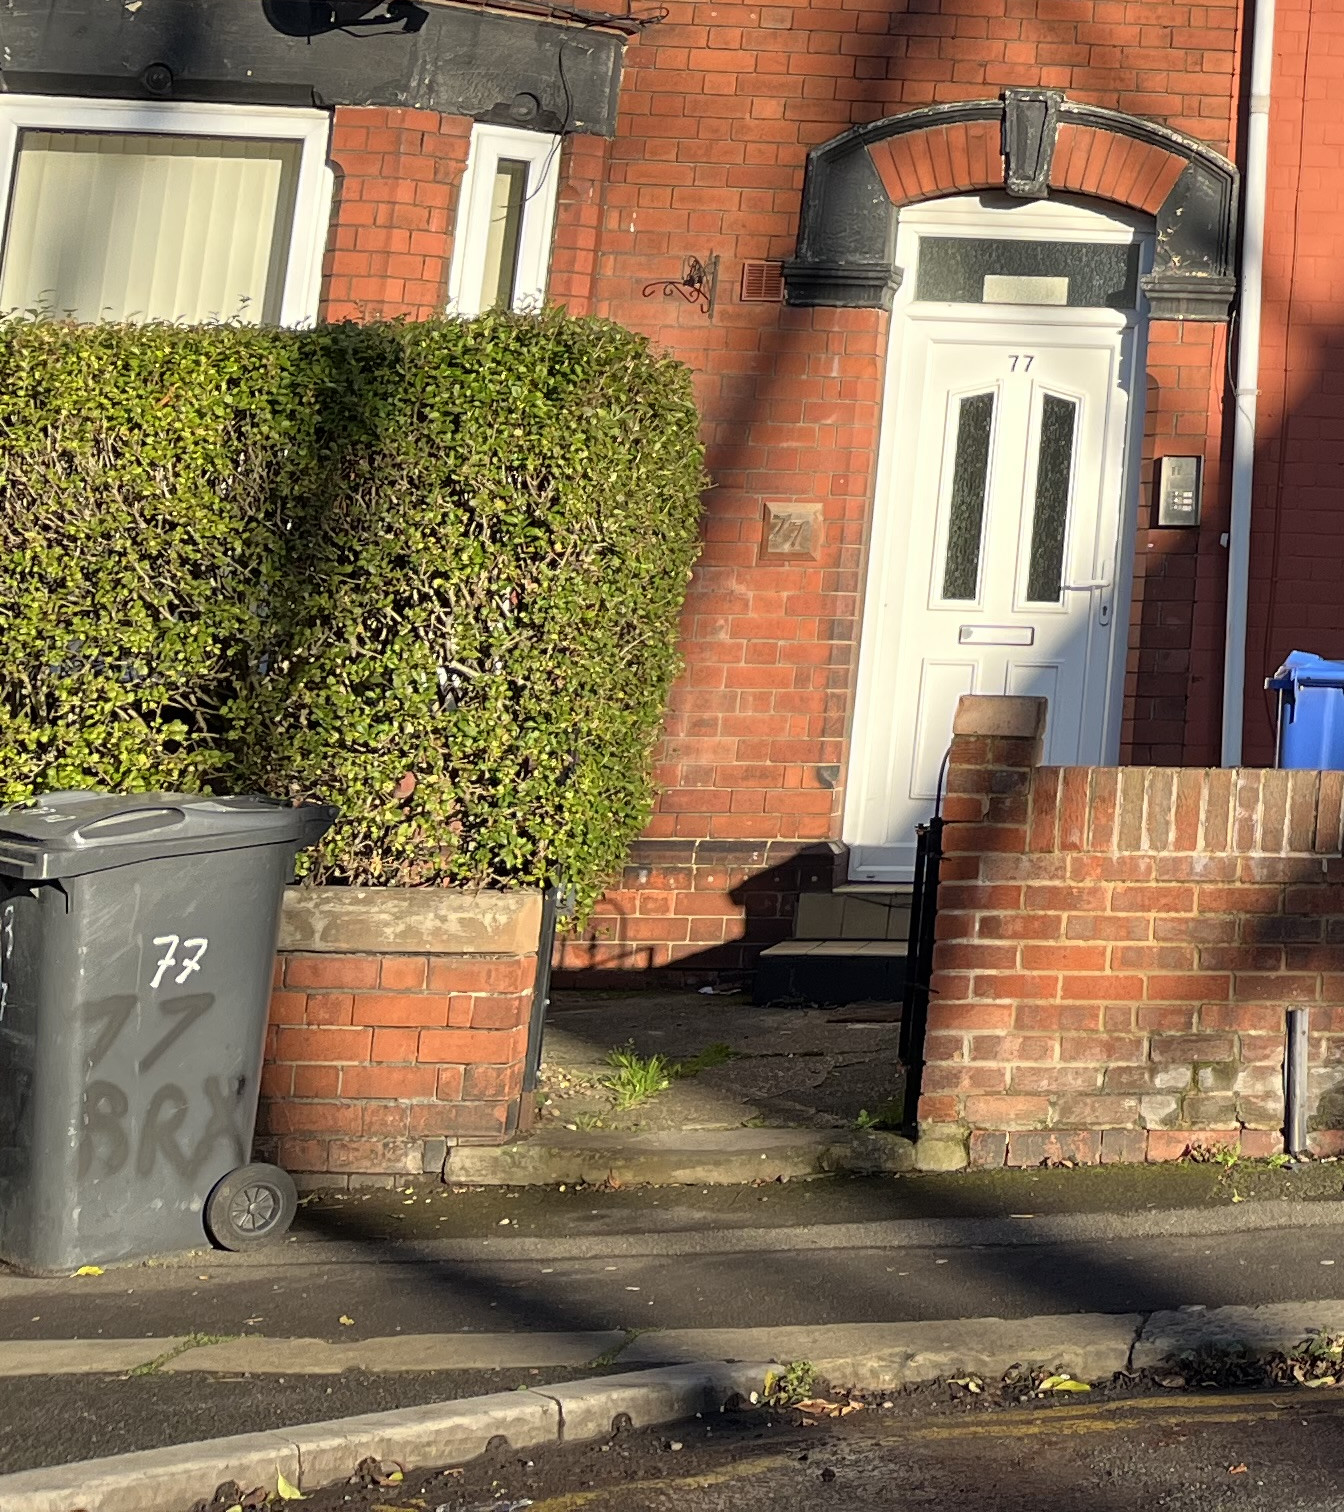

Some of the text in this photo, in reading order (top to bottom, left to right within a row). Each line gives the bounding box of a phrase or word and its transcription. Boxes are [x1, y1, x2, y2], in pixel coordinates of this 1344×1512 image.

[1008, 355, 1035, 372] 77
[769, 513, 810, 551] 77
[150, 934, 209, 989] 77
